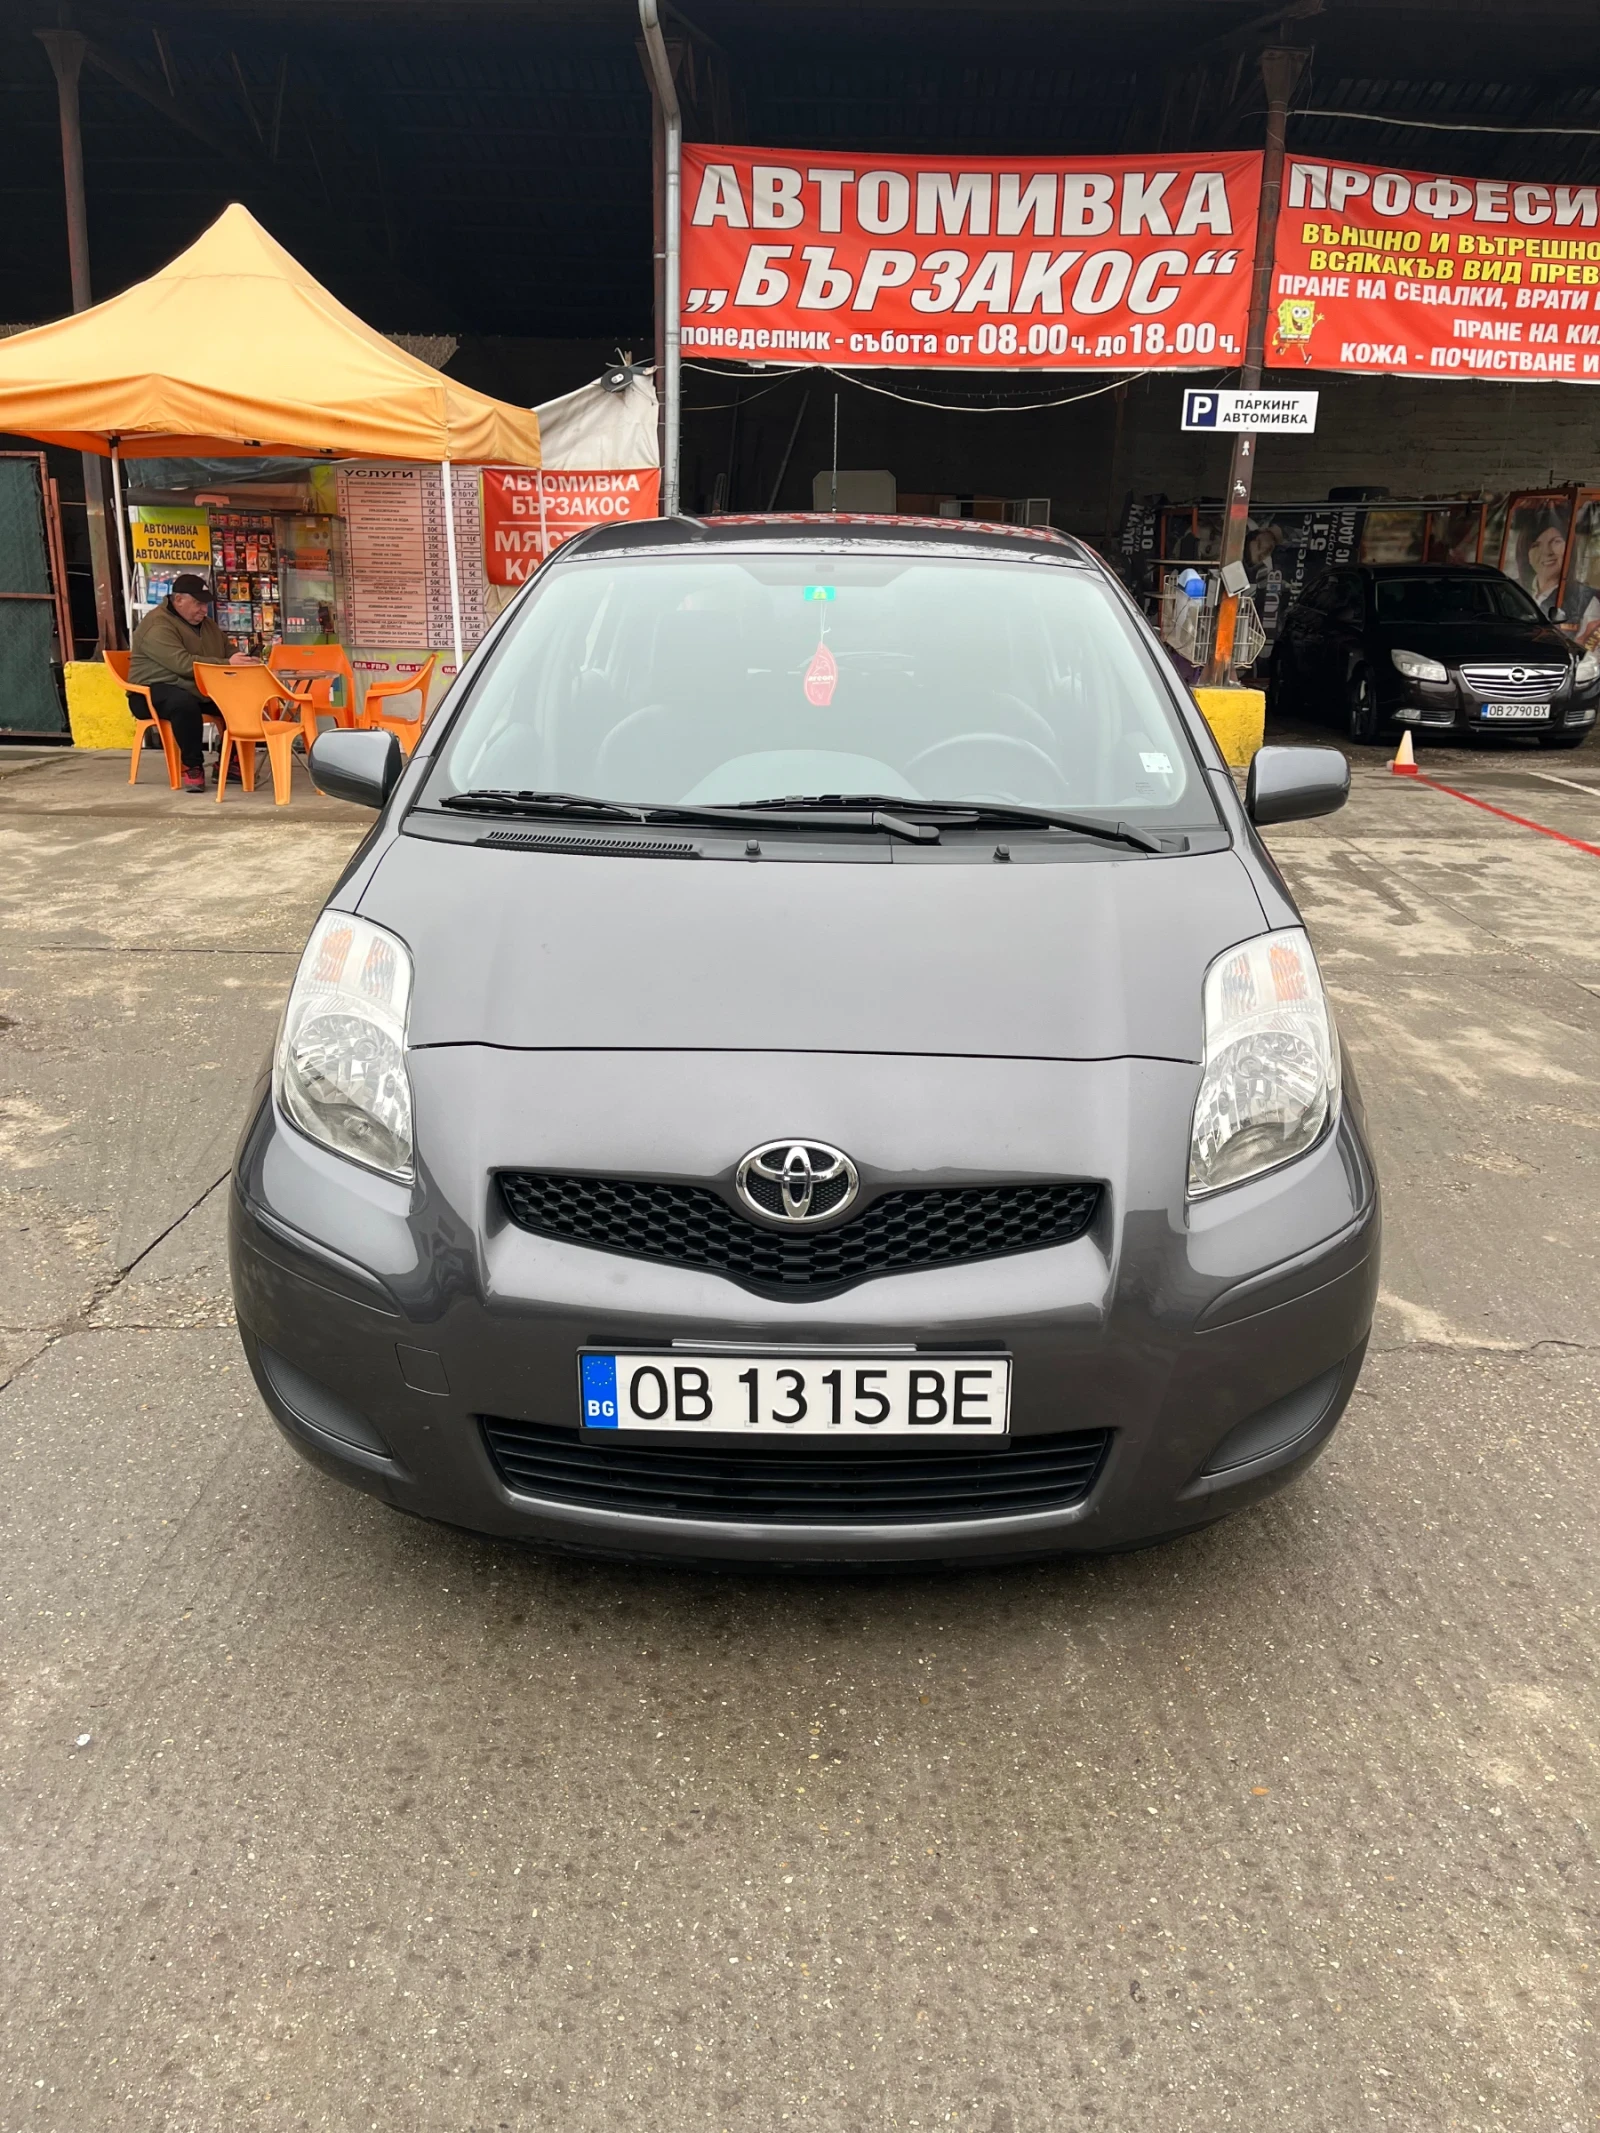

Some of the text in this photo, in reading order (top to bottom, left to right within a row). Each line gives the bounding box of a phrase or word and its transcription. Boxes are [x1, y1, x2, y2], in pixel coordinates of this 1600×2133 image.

[691, 164, 1234, 237] АВТОМИВКА
[1287, 162, 1599, 228] ПРОФЕСИ
[1301, 222, 1600, 262] ВЪНШНО И ВЪТРЕШНО
[1309, 249, 1600, 285] ВСЯКАКЪВ ВИД ПРЕВ
[1277, 274, 1350, 298] ПРАНЕ
[1356, 279, 1387, 300] НА
[1394, 280, 1508, 310] СЕДАЛКИ,
[1515, 288, 1589, 310] ВРАТИ
[681, 326, 831, 350] понеделник
[849, 330, 938, 354] събота
[945, 335, 974, 354] от
[977, 323, 1069, 355] 08.00
[1070, 335, 1091, 355] ч.
[1094, 335, 1127, 357] до
[1128, 322, 1216, 355] 18.00
[1219, 334, 1241, 354] ч.
[1453, 318, 1600, 345] ПРАНЕ НА КИ
[1340, 342, 1407, 365] КОЖА
[1430, 347, 1576, 373] ПОЧИСТВАНЕ
[1582, 353, 1599, 373] И
[1235, 399, 1300, 411] ПАРКИНГ
[1222, 412, 1308, 424] АВТОМИВКА
[344, 469, 413, 478] УСЛУГИ
[144, 523, 199, 536] АВТОМИВКА
[495, 530, 580, 552] МЯС
[135, 548, 210, 561] АВТОАКСЕСОАРИ
[148, 537, 197, 549] БЪРЗАКОС
[1489, 705, 1548, 717] OB 2790 BX
[629, 1365, 993, 1425] OB 1315 BE
[588, 1401, 614, 1417] BG
